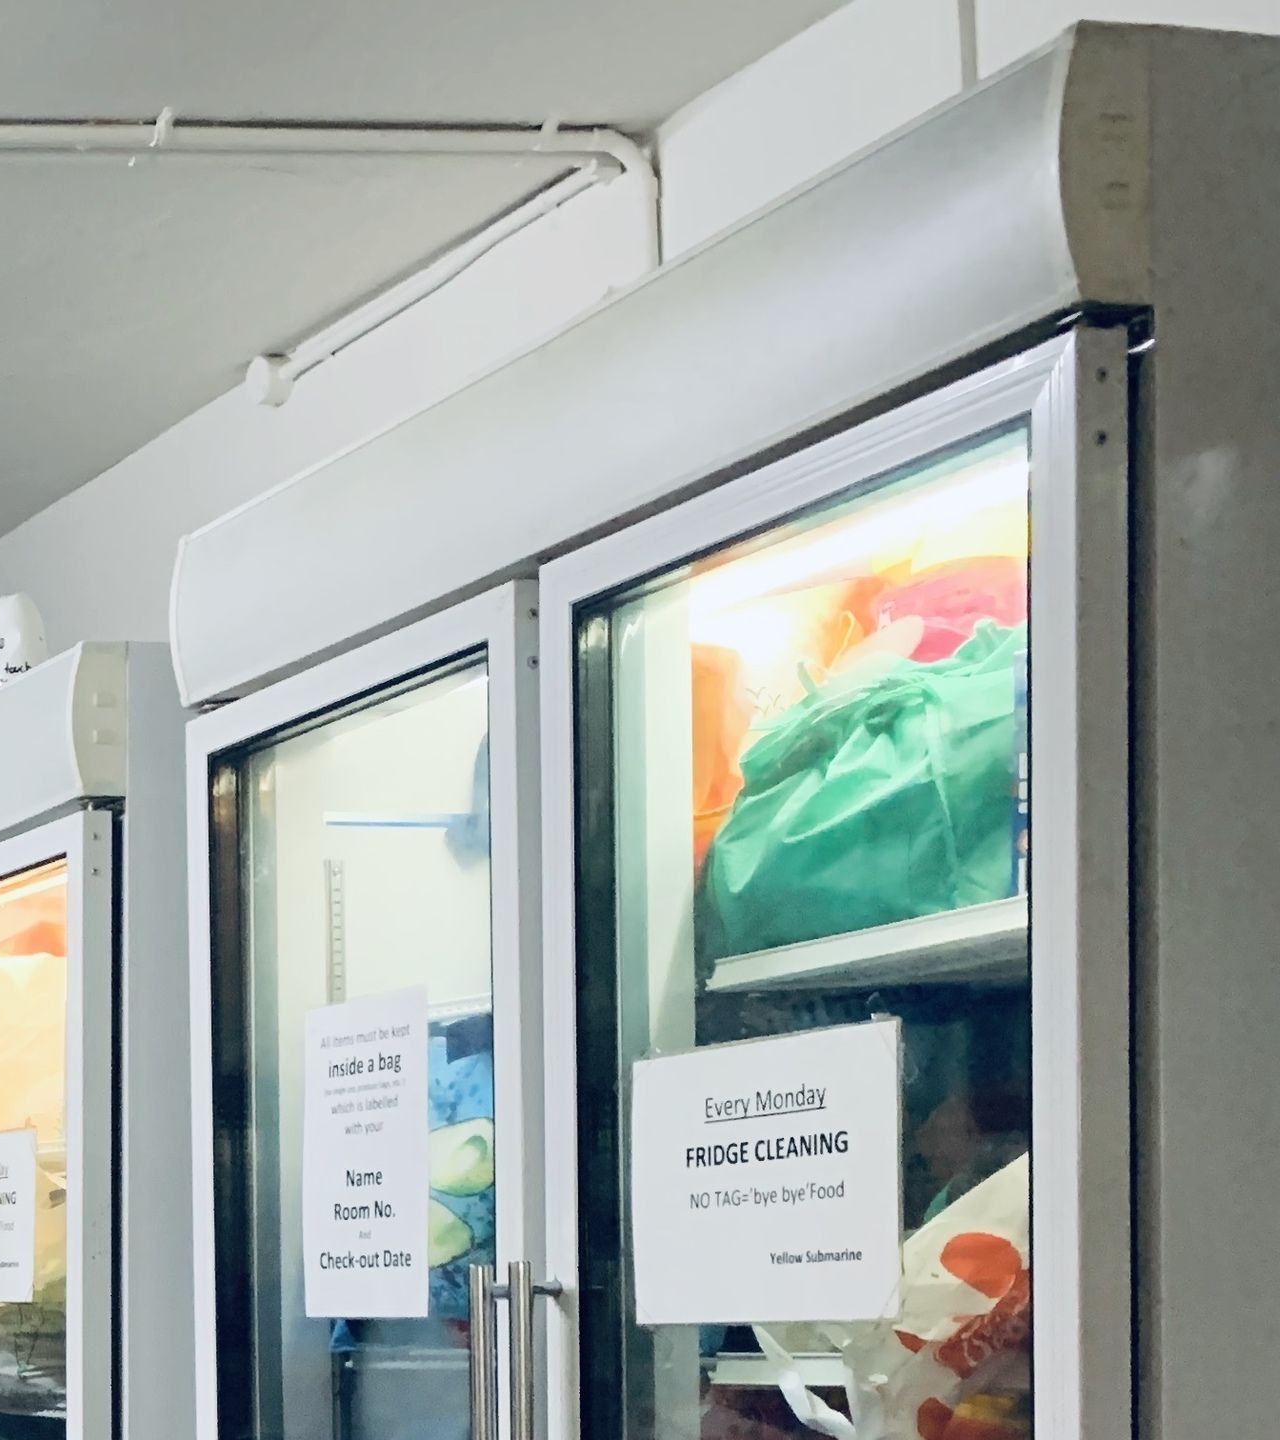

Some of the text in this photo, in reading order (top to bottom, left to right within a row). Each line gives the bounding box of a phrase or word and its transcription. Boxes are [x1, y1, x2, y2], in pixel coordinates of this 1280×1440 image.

[379, 1028, 389, 1040] be
[392, 1024, 410, 1038] kept
[328, 1052, 402, 1078] inside a bag
[704, 1083, 827, 1120] Every Monday
[686, 1131, 849, 1168] FRIDGE CLEANING
[346, 1169, 383, 1187] Name
[334, 1200, 396, 1221] Room No.
[690, 1192, 711, 1209] NO
[320, 1249, 412, 1270] Check-out Date
[770, 1249, 863, 1265] Yellow Submarine
